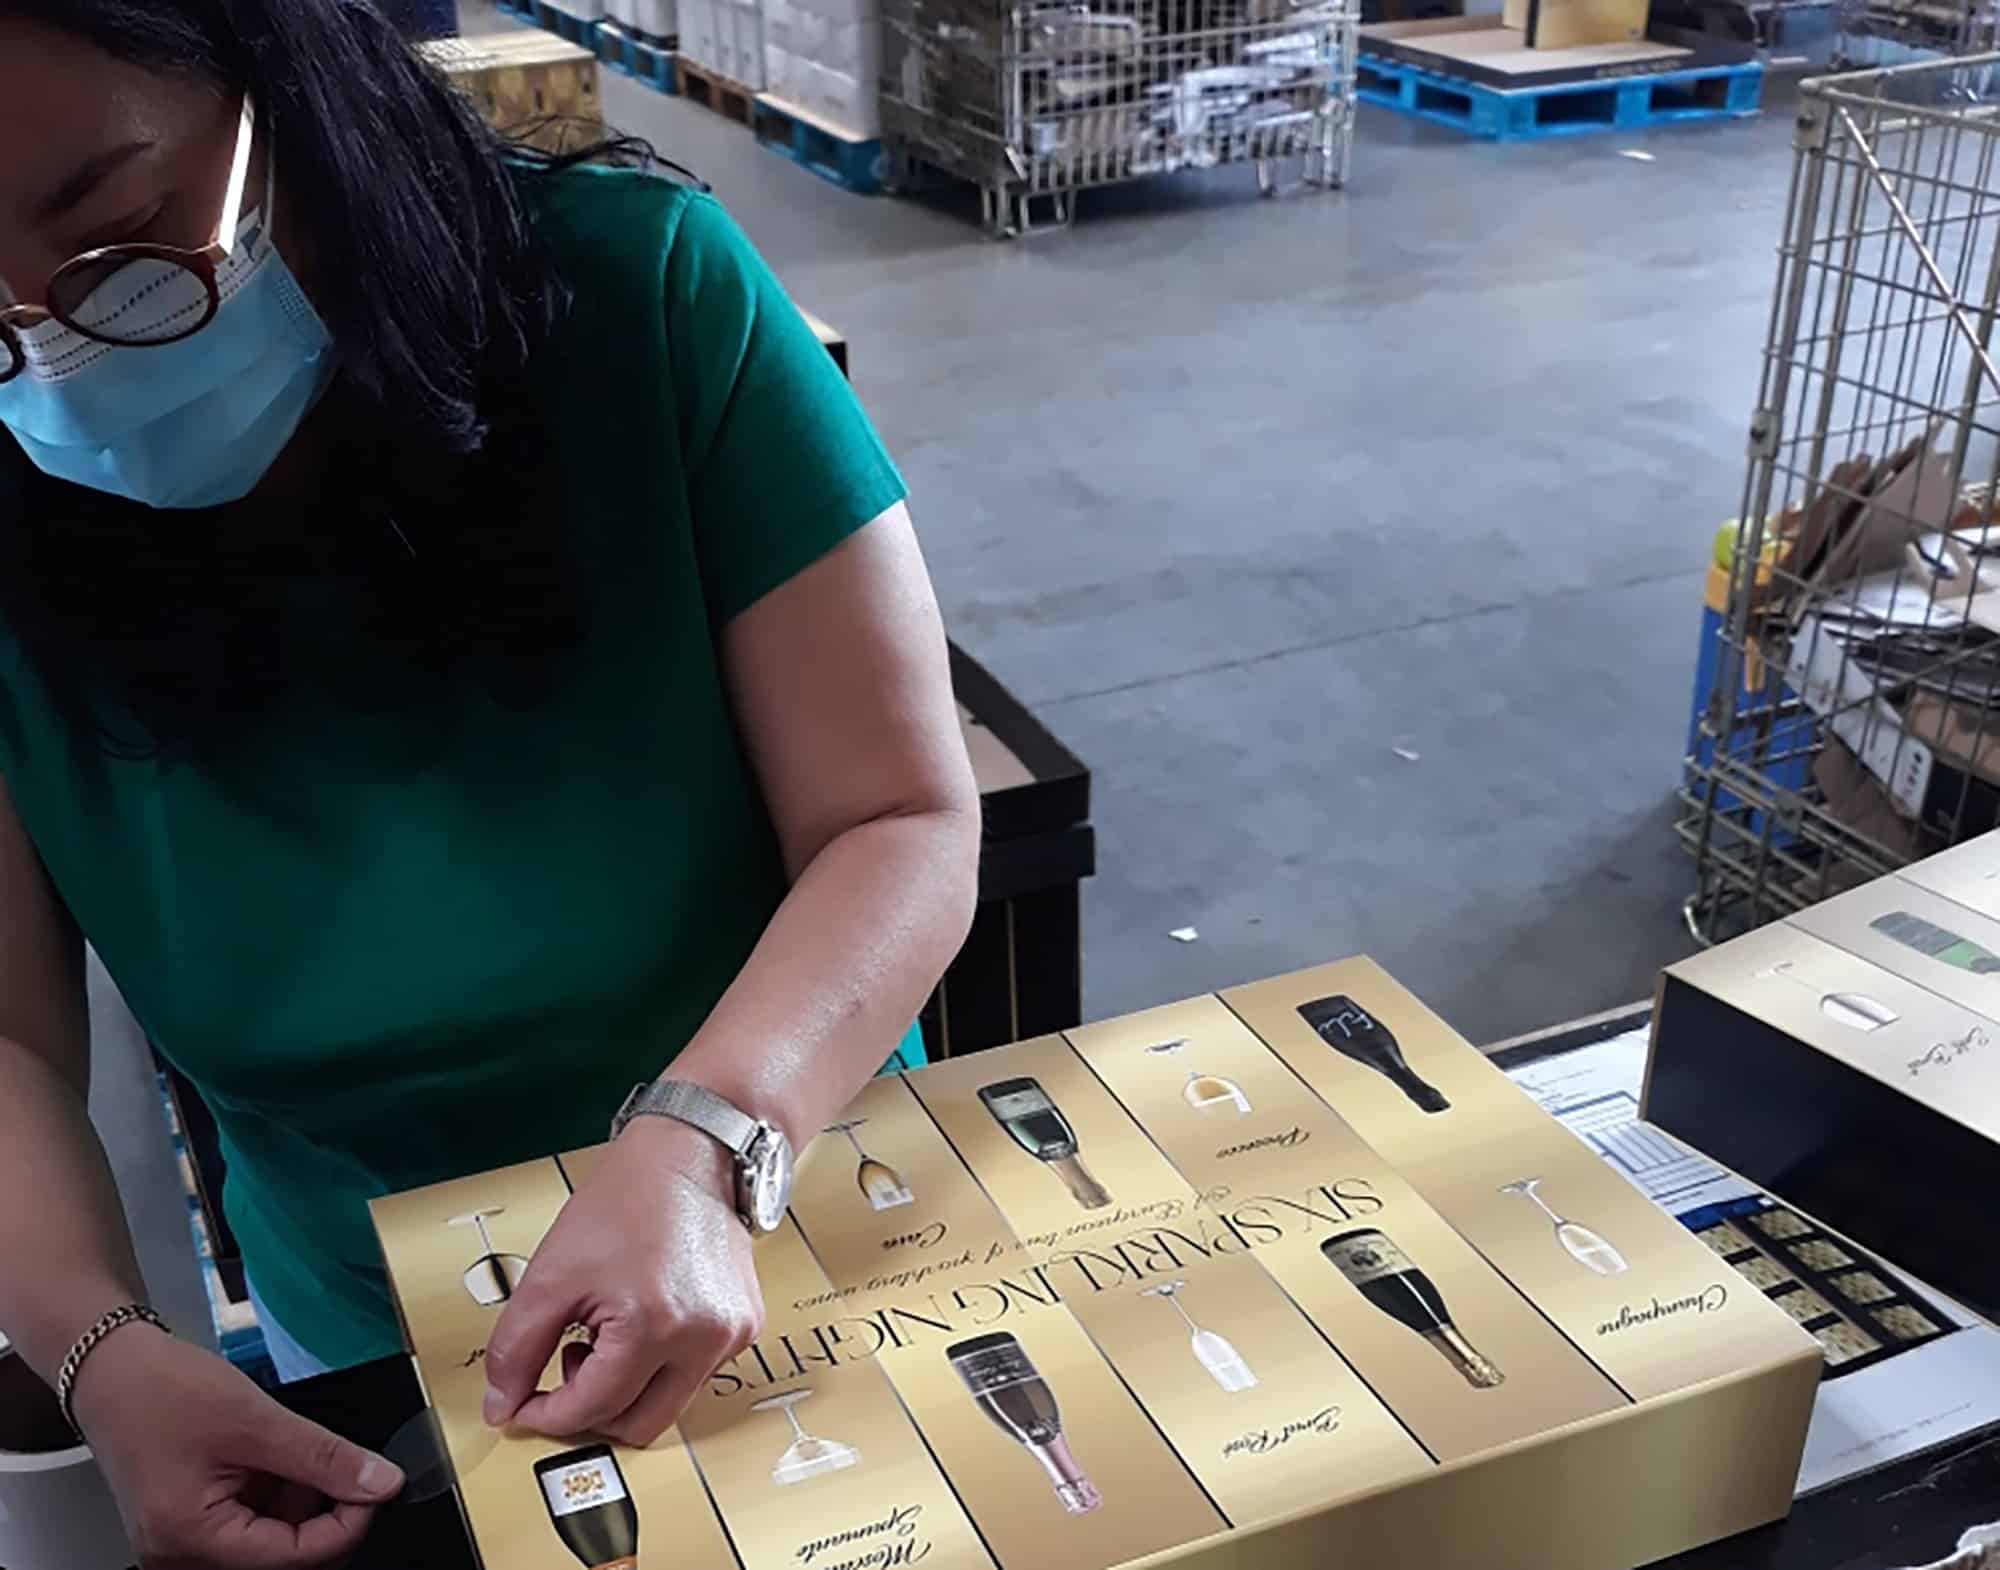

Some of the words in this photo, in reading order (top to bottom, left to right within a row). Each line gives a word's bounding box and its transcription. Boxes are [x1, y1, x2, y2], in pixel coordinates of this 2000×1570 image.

[1216, 1128, 1311, 1159] Prosecco
[1252, 1177, 1384, 1233] SIX
[881, 1221, 947, 1250] Cava
[866, 1249, 975, 1291] sparkling
[952, 1205, 1283, 1324] SPARKLING
[792, 1282, 860, 1312] wines
[1595, 1283, 1728, 1337] Champagne
[711, 1294, 952, 1395] NIGHTS
[1281, 1406, 1341, 1444] Brut
[794, 1504, 923, 1563] Spumante
